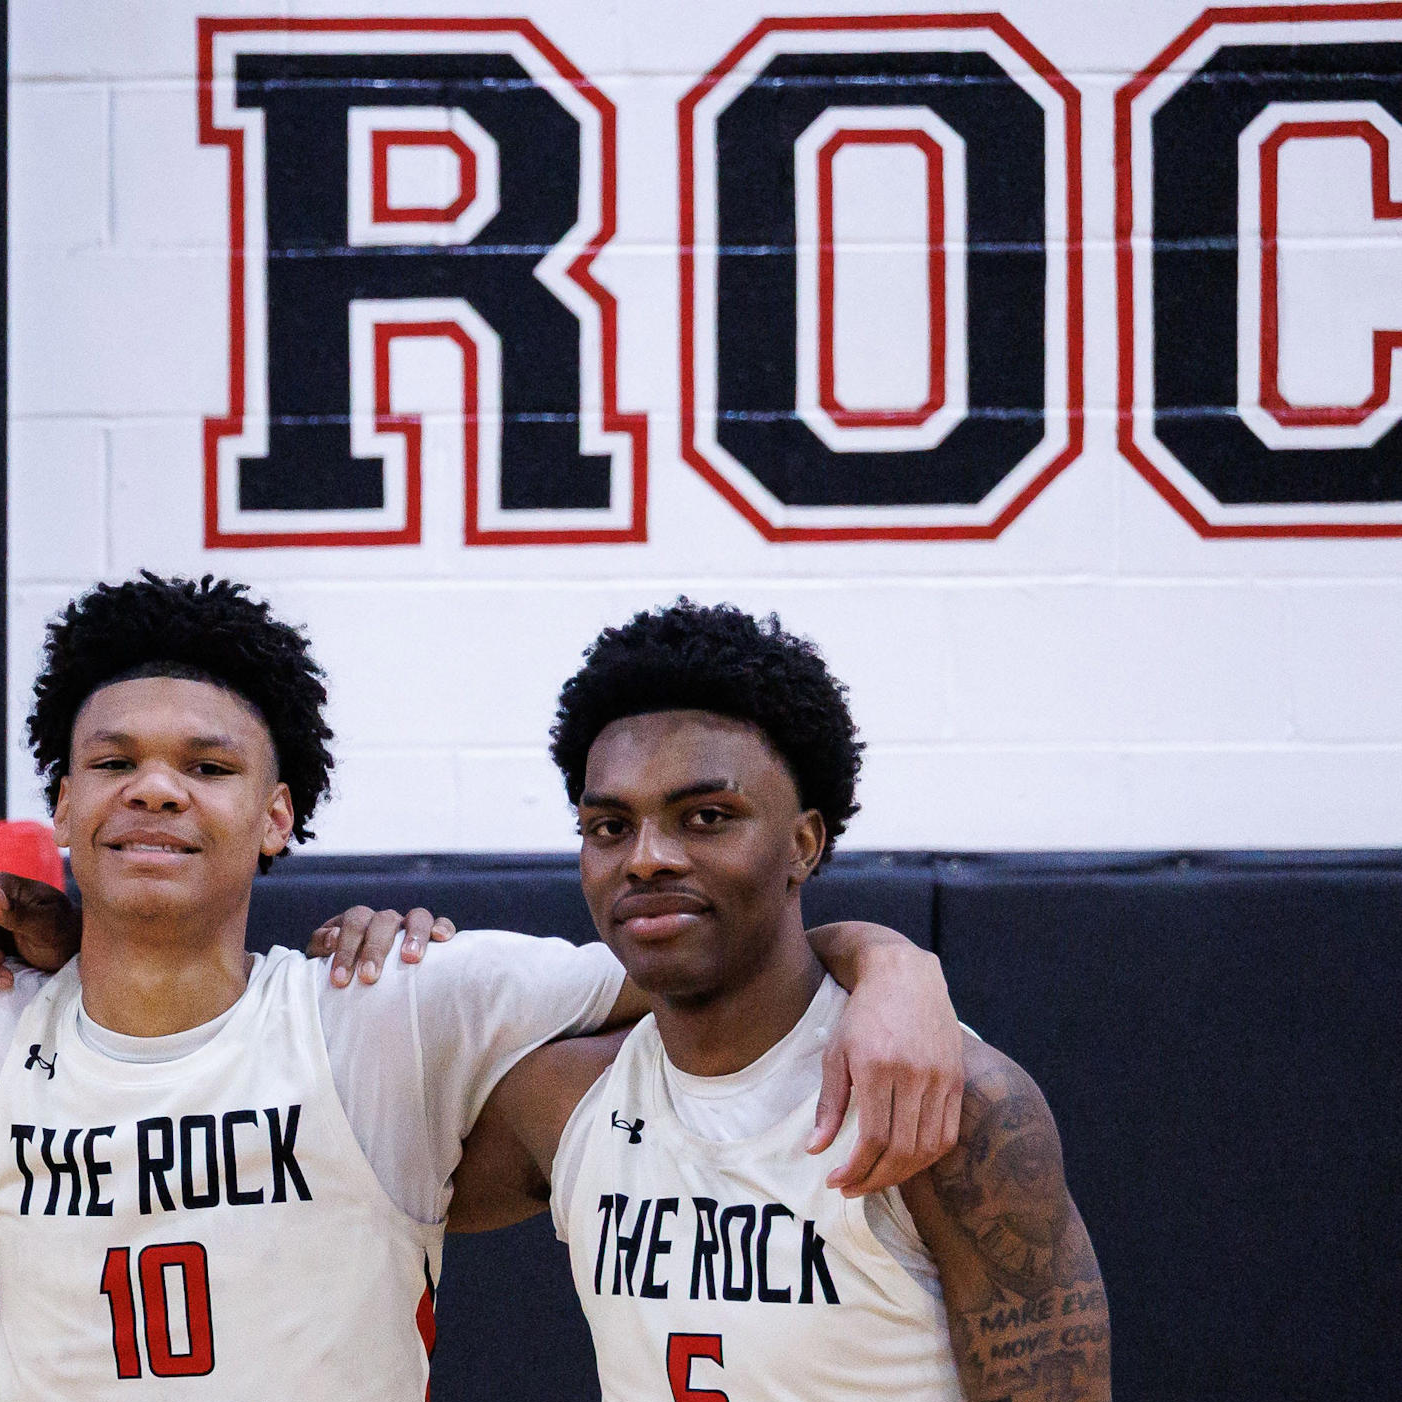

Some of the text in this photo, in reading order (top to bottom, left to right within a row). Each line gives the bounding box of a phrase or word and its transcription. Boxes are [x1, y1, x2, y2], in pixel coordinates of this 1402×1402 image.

[198, 4, 1402, 547] ROC
[11, 1105, 312, 1216] THE ROCK
[595, 1194, 840, 1304] THE ROCK
[100, 1242, 215, 1379] 10
[979, 1297, 1054, 1337] MAKE
[991, 1329, 1053, 1359] MOVE
